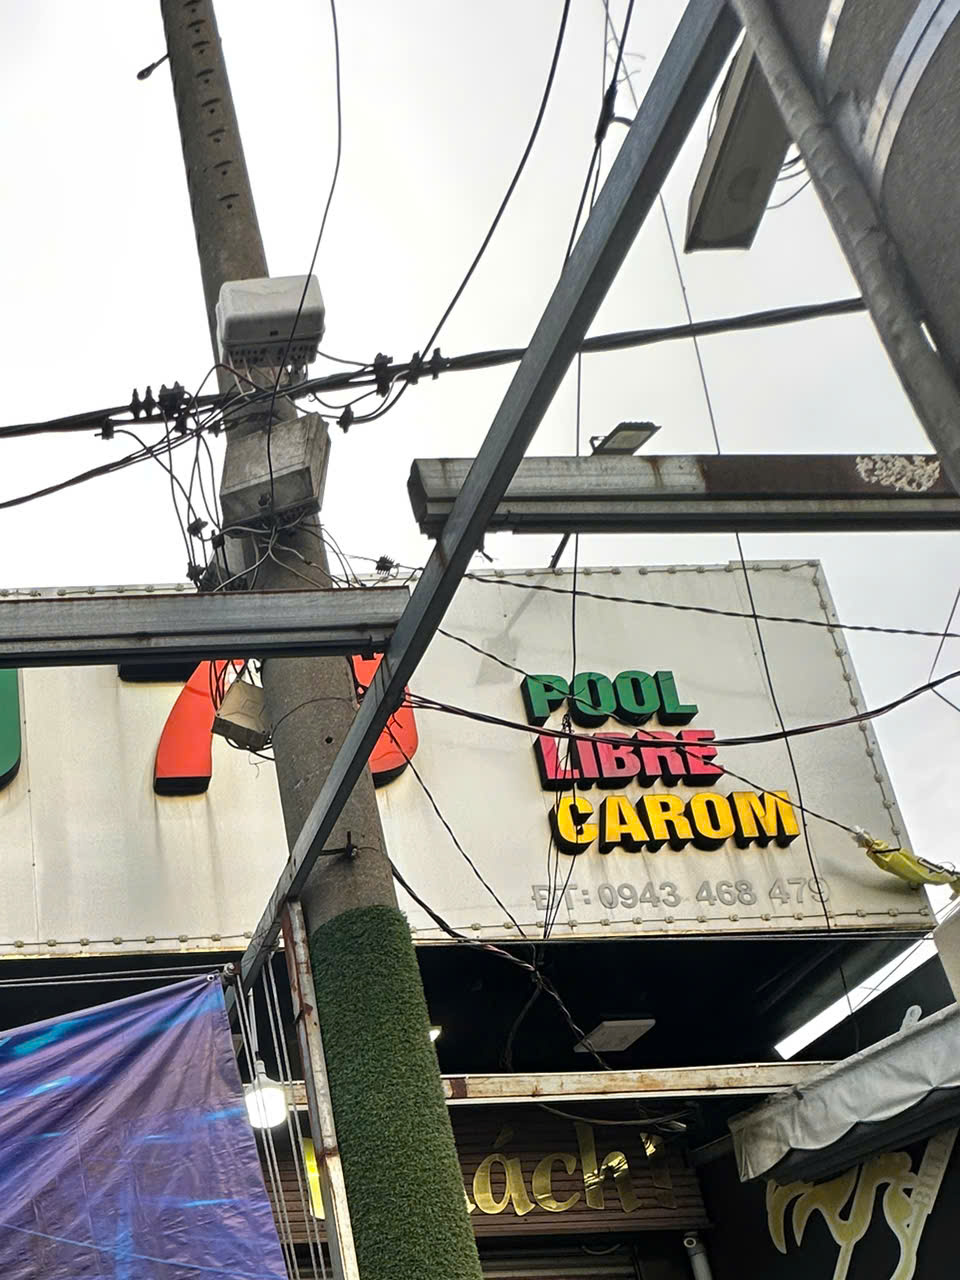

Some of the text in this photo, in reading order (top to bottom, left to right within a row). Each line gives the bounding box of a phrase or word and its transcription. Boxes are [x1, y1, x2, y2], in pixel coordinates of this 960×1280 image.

[521, 670, 699, 728] POOL
[533, 729, 724, 790] LIBRE
[549, 791, 800, 855] CAROM
[597, 881, 681, 910] 0943
[696, 879, 757, 906] 468
[769, 876, 831, 904] 479
